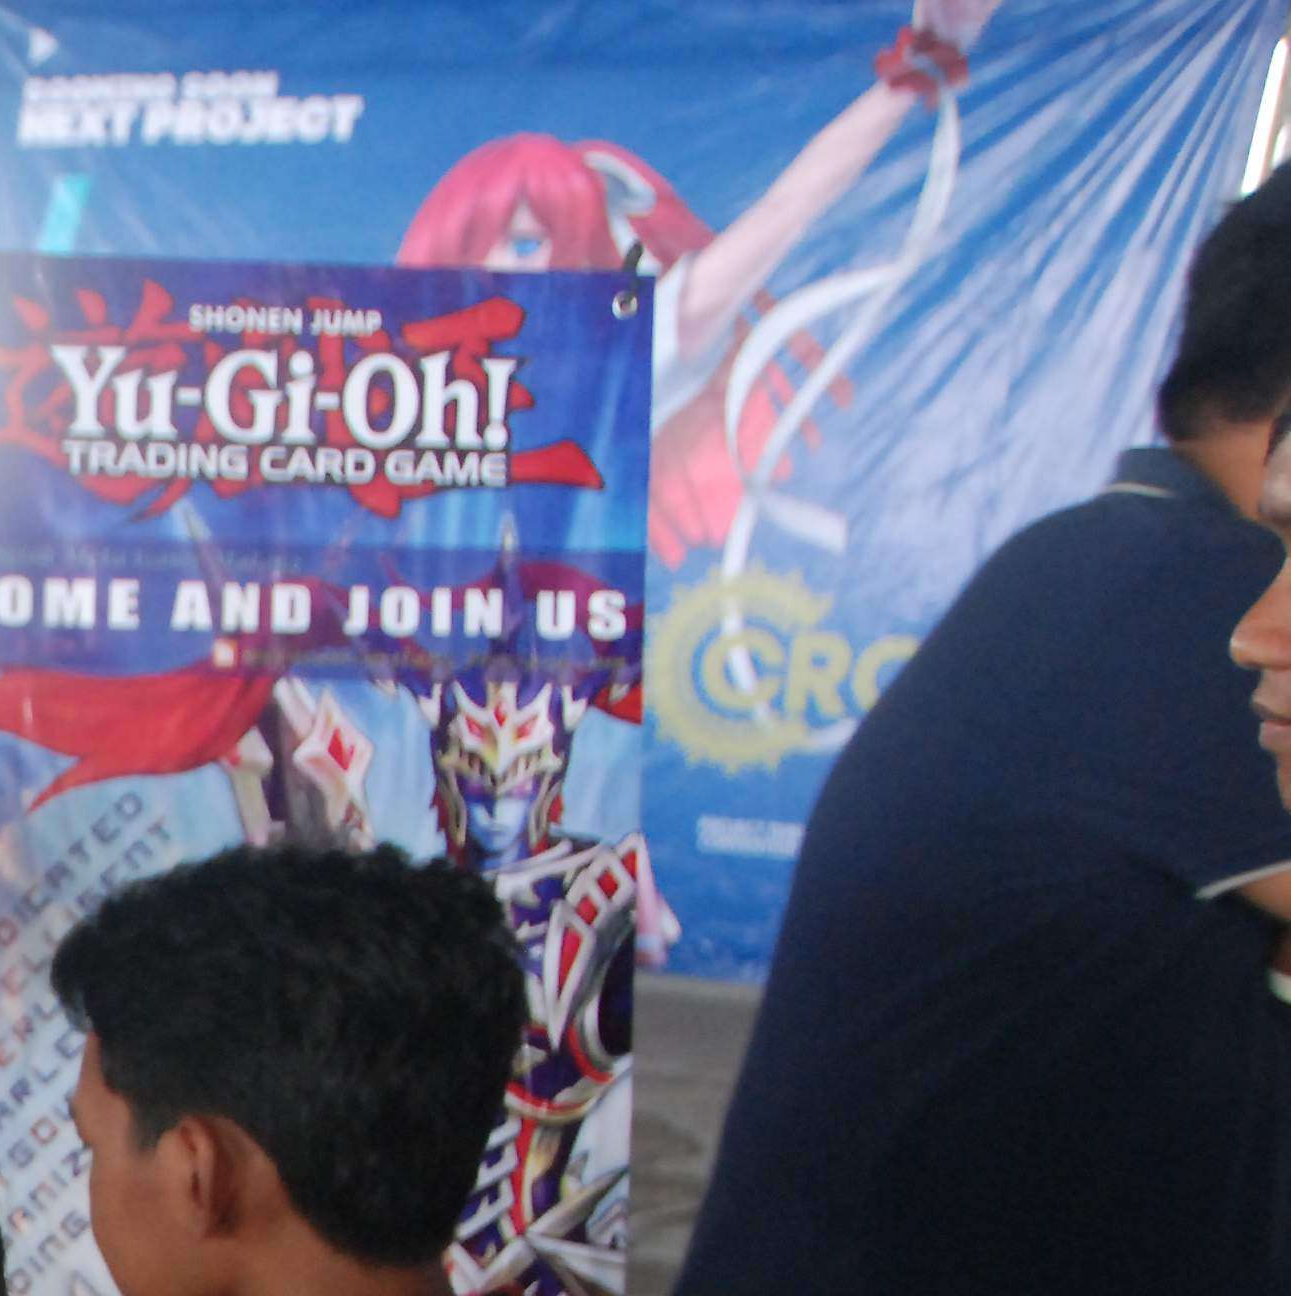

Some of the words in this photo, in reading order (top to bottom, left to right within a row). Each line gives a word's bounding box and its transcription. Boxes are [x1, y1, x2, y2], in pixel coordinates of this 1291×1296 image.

[18, 97, 141, 147] NEXT
[141, 93, 365, 145] PROJECT
[189, 304, 303, 335] SHONEN
[311, 308, 382, 337] JUMP
[51, 344, 517, 452] Yu-Gi-Oh!
[62, 440, 249, 481] TRADING
[260, 445, 376, 486] CARD
[384, 449, 508, 488] GAME
[170, 578, 312, 634] AND
[342, 584, 504, 638] JOIN
[535, 588, 627, 641] US
